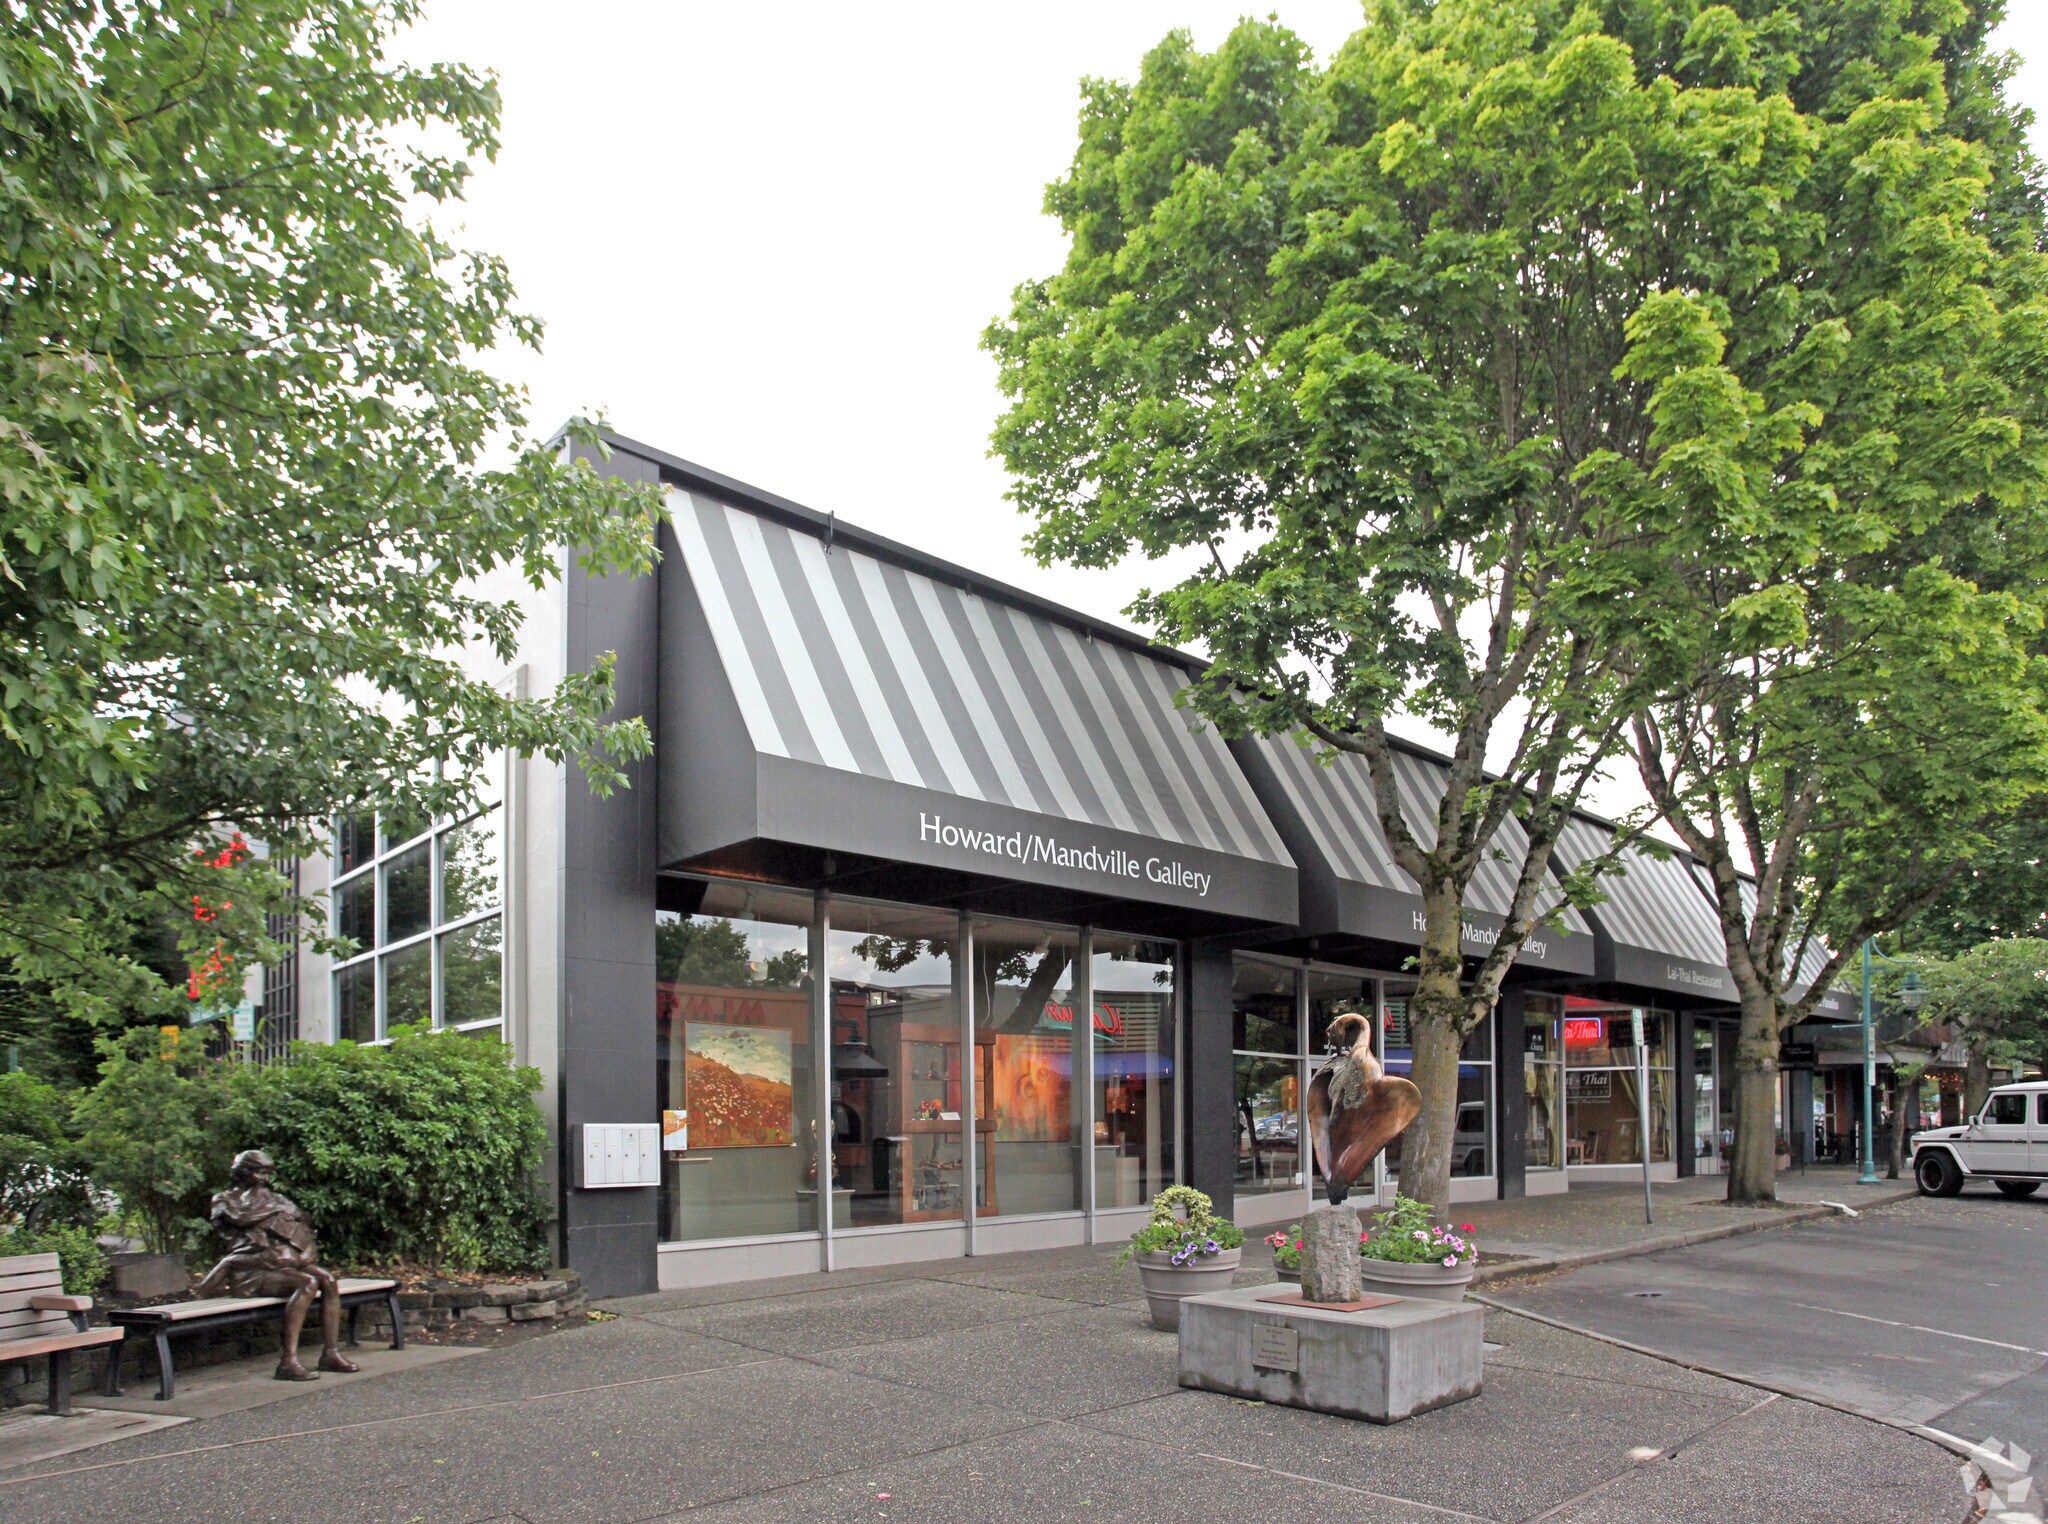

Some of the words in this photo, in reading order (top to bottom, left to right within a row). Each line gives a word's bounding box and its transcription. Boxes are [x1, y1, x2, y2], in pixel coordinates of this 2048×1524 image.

[919, 812, 1141, 878] Howard/Mandville
[1145, 857, 1212, 897] Gallery
[1520, 935, 1547, 959] allery
[1564, 1021, 1598, 1039] ai-Thai
[1582, 1072, 1609, 1086] Thai
